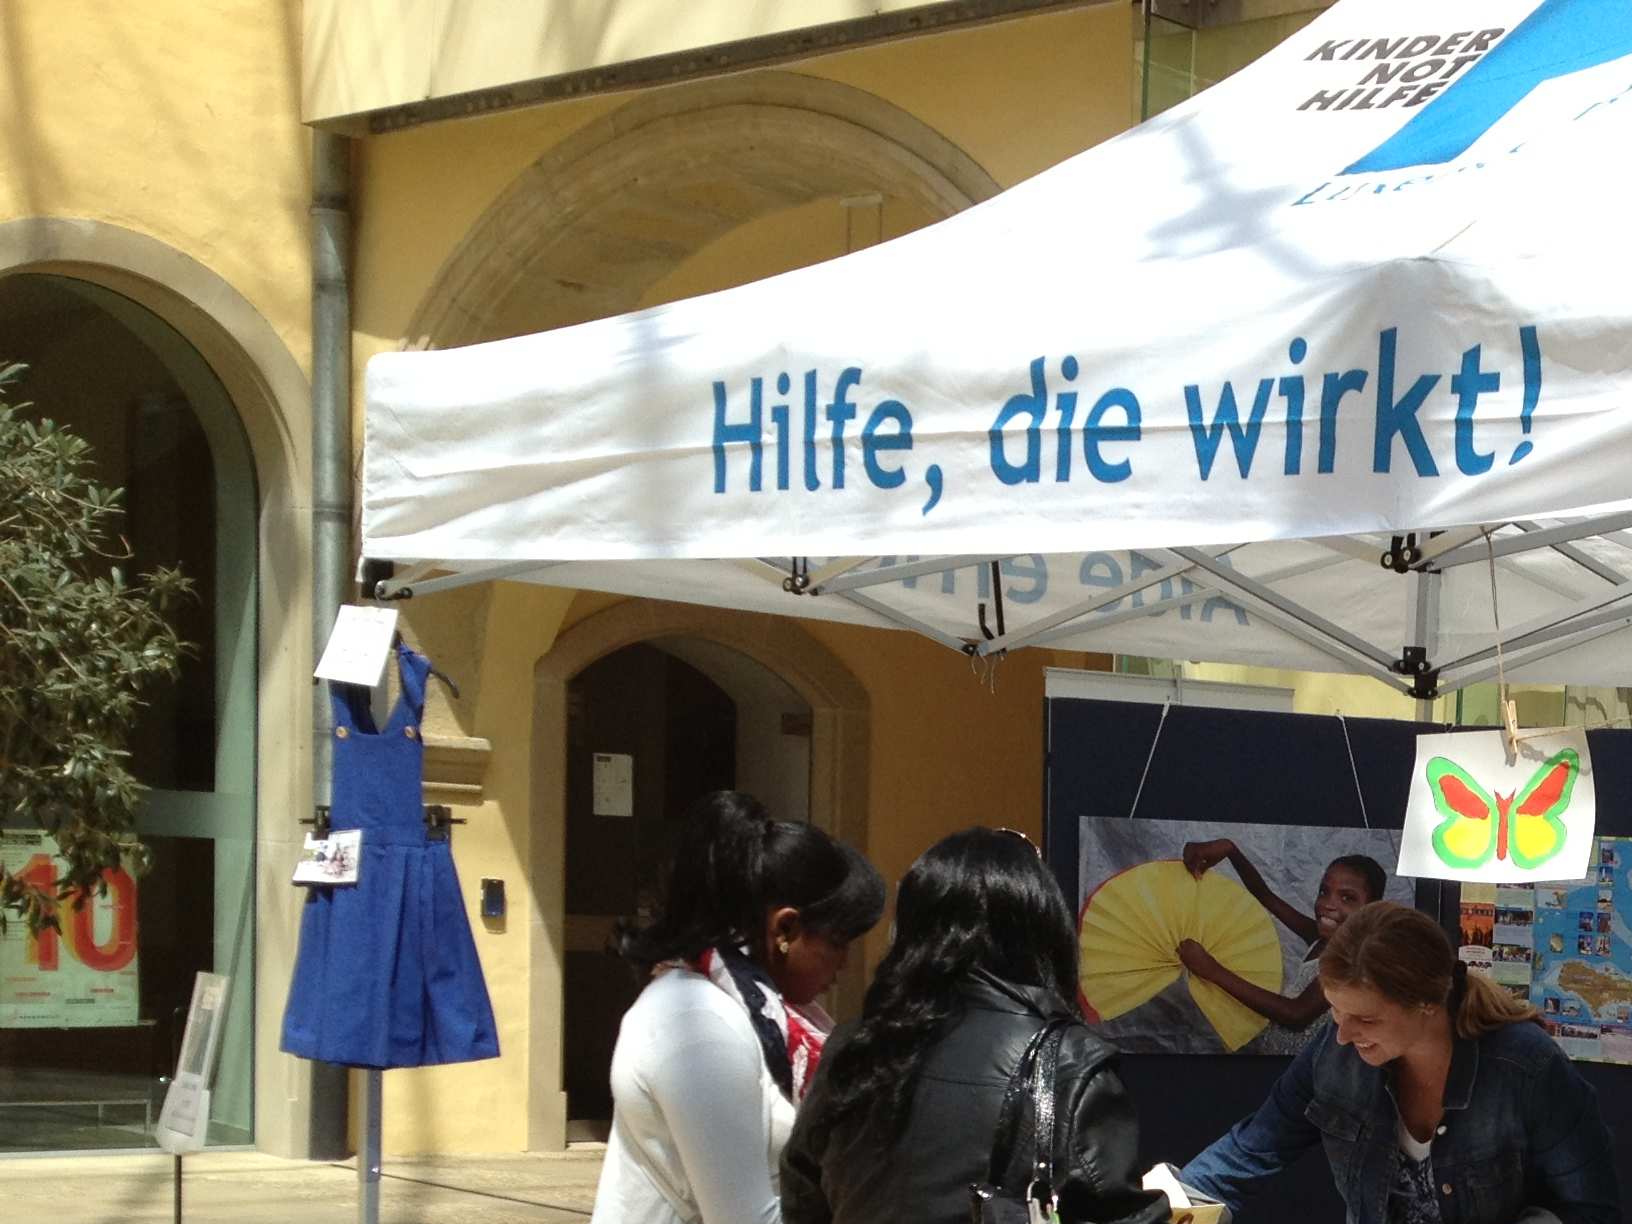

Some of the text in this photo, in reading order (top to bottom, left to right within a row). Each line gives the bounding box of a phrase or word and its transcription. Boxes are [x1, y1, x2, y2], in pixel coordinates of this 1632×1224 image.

[1303, 28, 1505, 61] KINDER
[1357, 53, 1483, 85] NOT
[1296, 81, 1449, 111] HILFE
[711, 326, 1543, 518] Hilfe, die wirkt!
